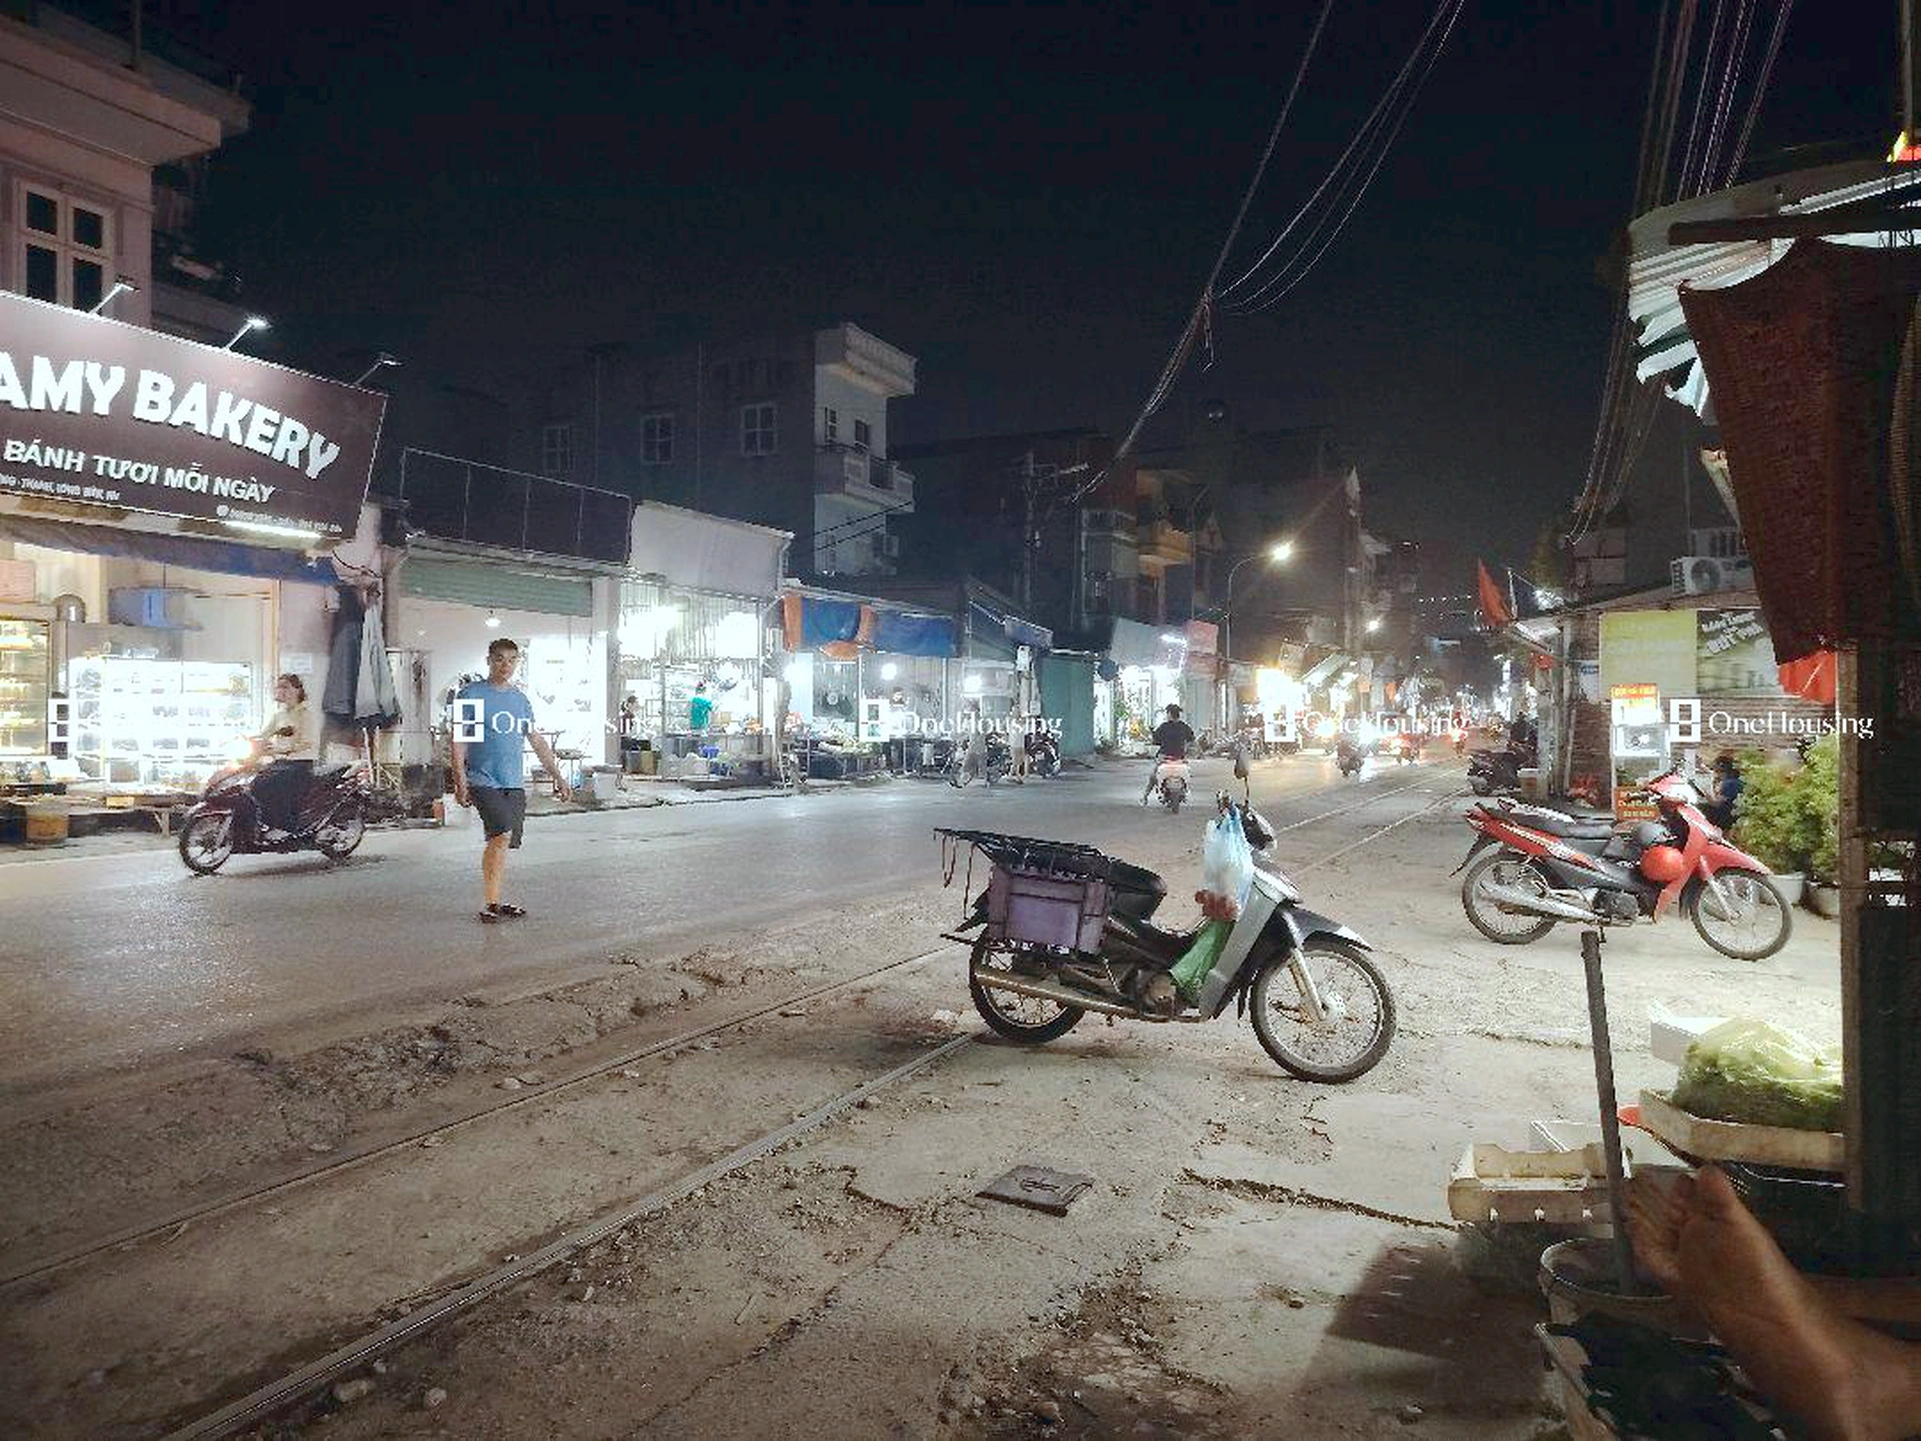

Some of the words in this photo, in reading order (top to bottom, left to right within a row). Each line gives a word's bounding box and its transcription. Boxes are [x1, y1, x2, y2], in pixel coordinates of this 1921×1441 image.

[133, 369, 340, 480] BAKERY
[3, 436, 85, 473] BÁNH
[93, 455, 158, 483] TƯƠI
[164, 461, 208, 494] MỖI
[213, 475, 276, 503] NGÀY
